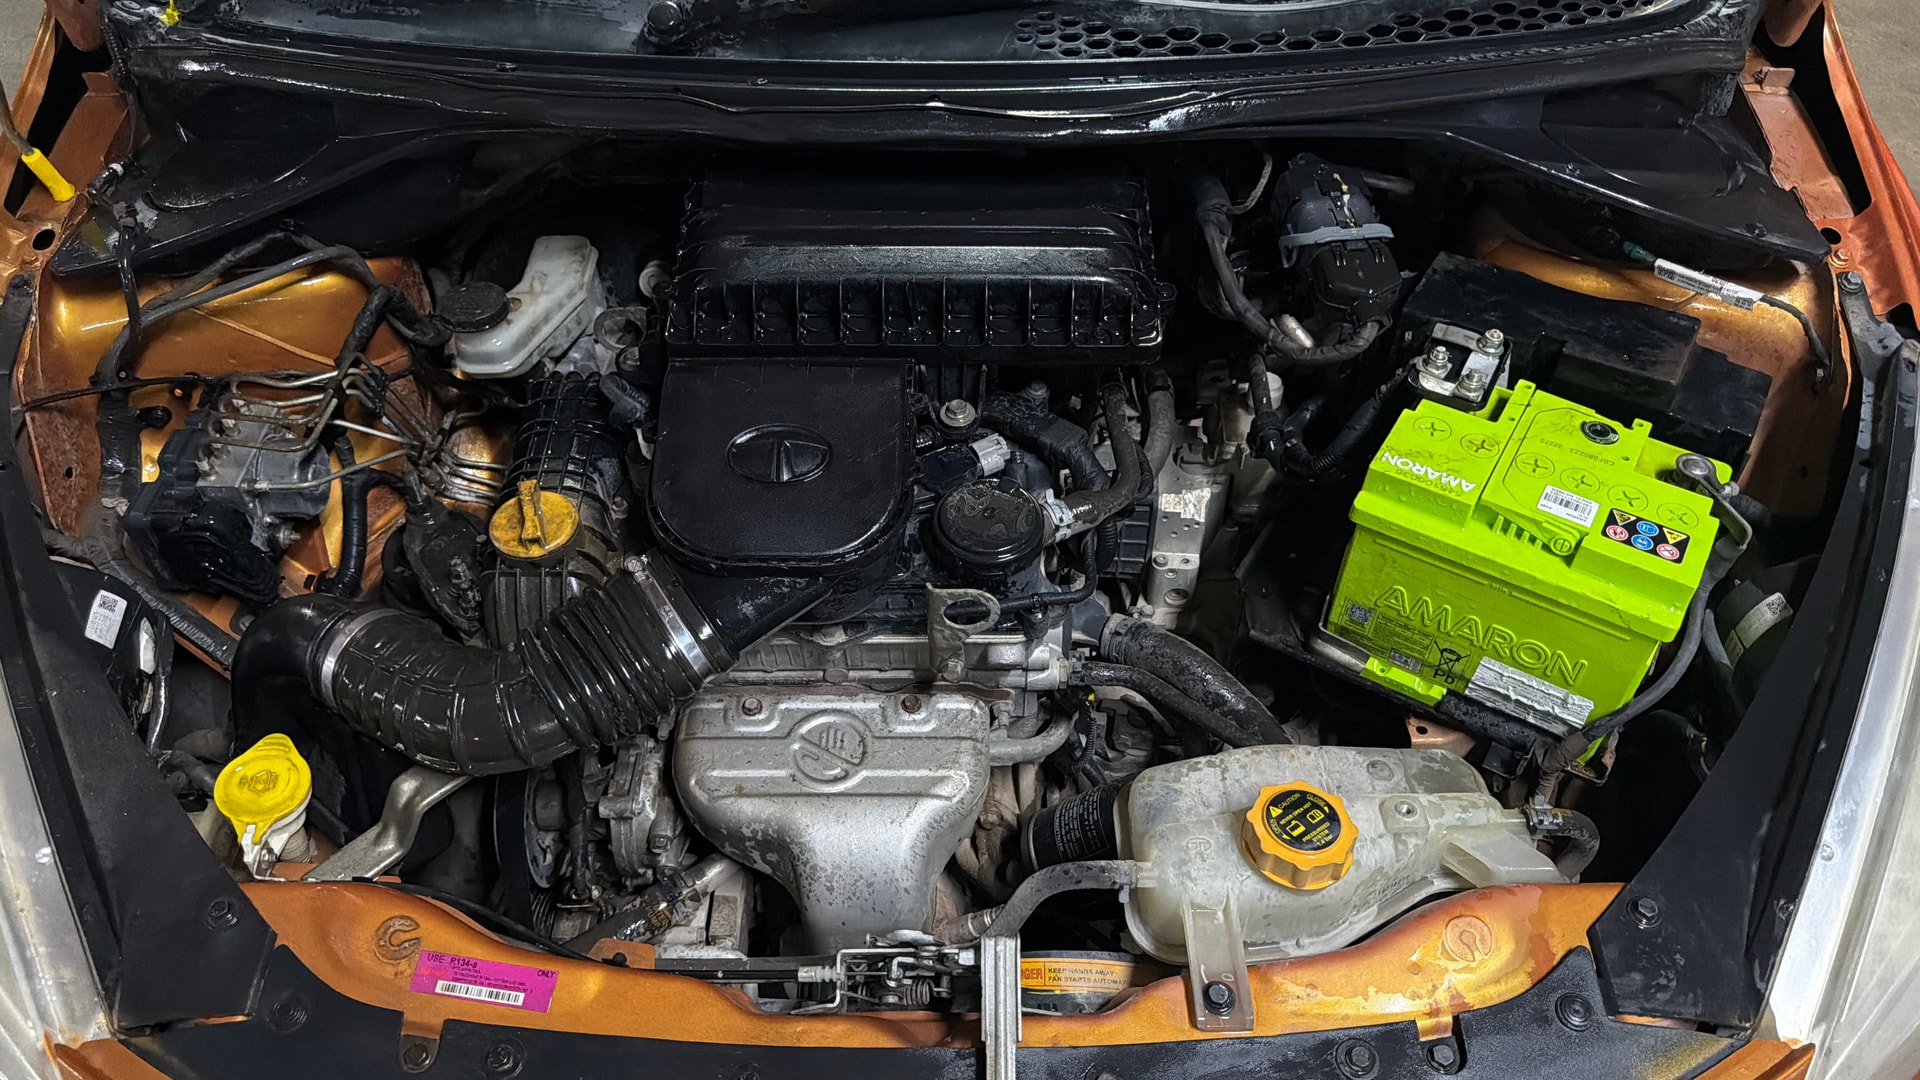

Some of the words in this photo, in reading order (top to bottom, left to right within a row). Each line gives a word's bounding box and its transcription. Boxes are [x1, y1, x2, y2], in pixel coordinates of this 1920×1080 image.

[1381, 451, 1476, 492] AMARON
[1375, 585, 1588, 686] AMARON
[1433, 668, 1456, 685] Pb
[1278, 793, 1301, 809] CAUTION
[1306, 794, 1327, 807] CLOSE
[427, 953, 446, 963] USE
[537, 969, 556, 978] ONLY
